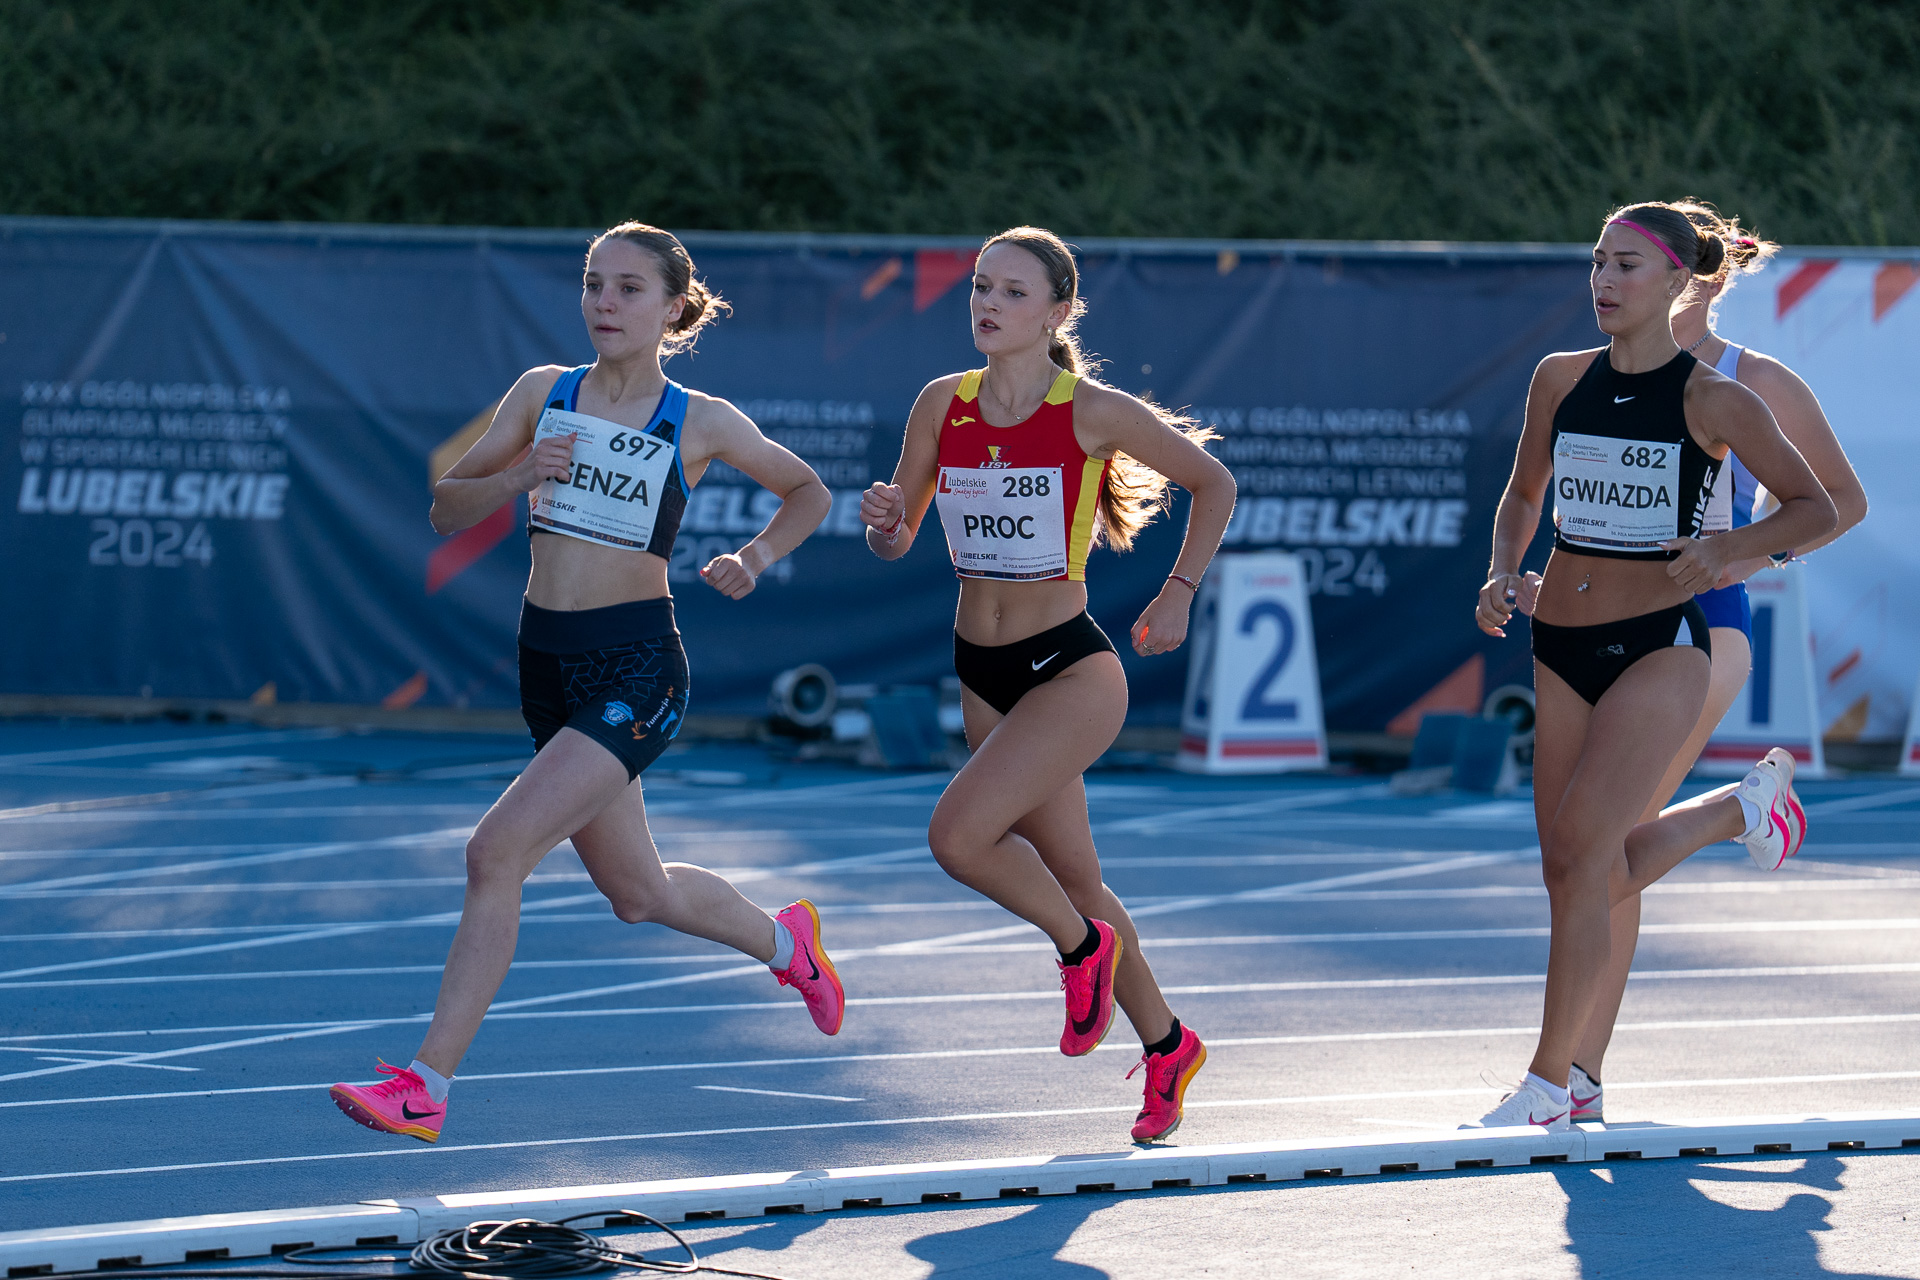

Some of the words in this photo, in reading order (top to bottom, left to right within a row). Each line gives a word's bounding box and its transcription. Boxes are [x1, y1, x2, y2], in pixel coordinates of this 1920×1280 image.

[22, 408, 154, 437] OLIMPIADA
[20, 438, 48, 464] W
[51, 439, 182, 467] SPORTACH
[185, 442, 287, 470] LETNICH
[609, 431, 663, 461] 697
[1621, 446, 1667, 469] 682
[979, 461, 1012, 469] LISY
[18, 468, 290, 520] LUBELSKIE
[1002, 475, 1050, 498] 288
[1559, 477, 1671, 509] GWIAZDA
[963, 515, 1036, 539] PROC
[1567, 524, 1586, 533] 2024
[1568, 516, 1608, 528] LUBELSKIE
[89, 519, 214, 568] 2024
[960, 551, 998, 561] LUBELSKIE
[960, 559, 977, 567] 2024
[1298, 547, 1389, 597] 024
[1239, 601, 1298, 721] 2
[1751, 604, 1774, 725] 1
